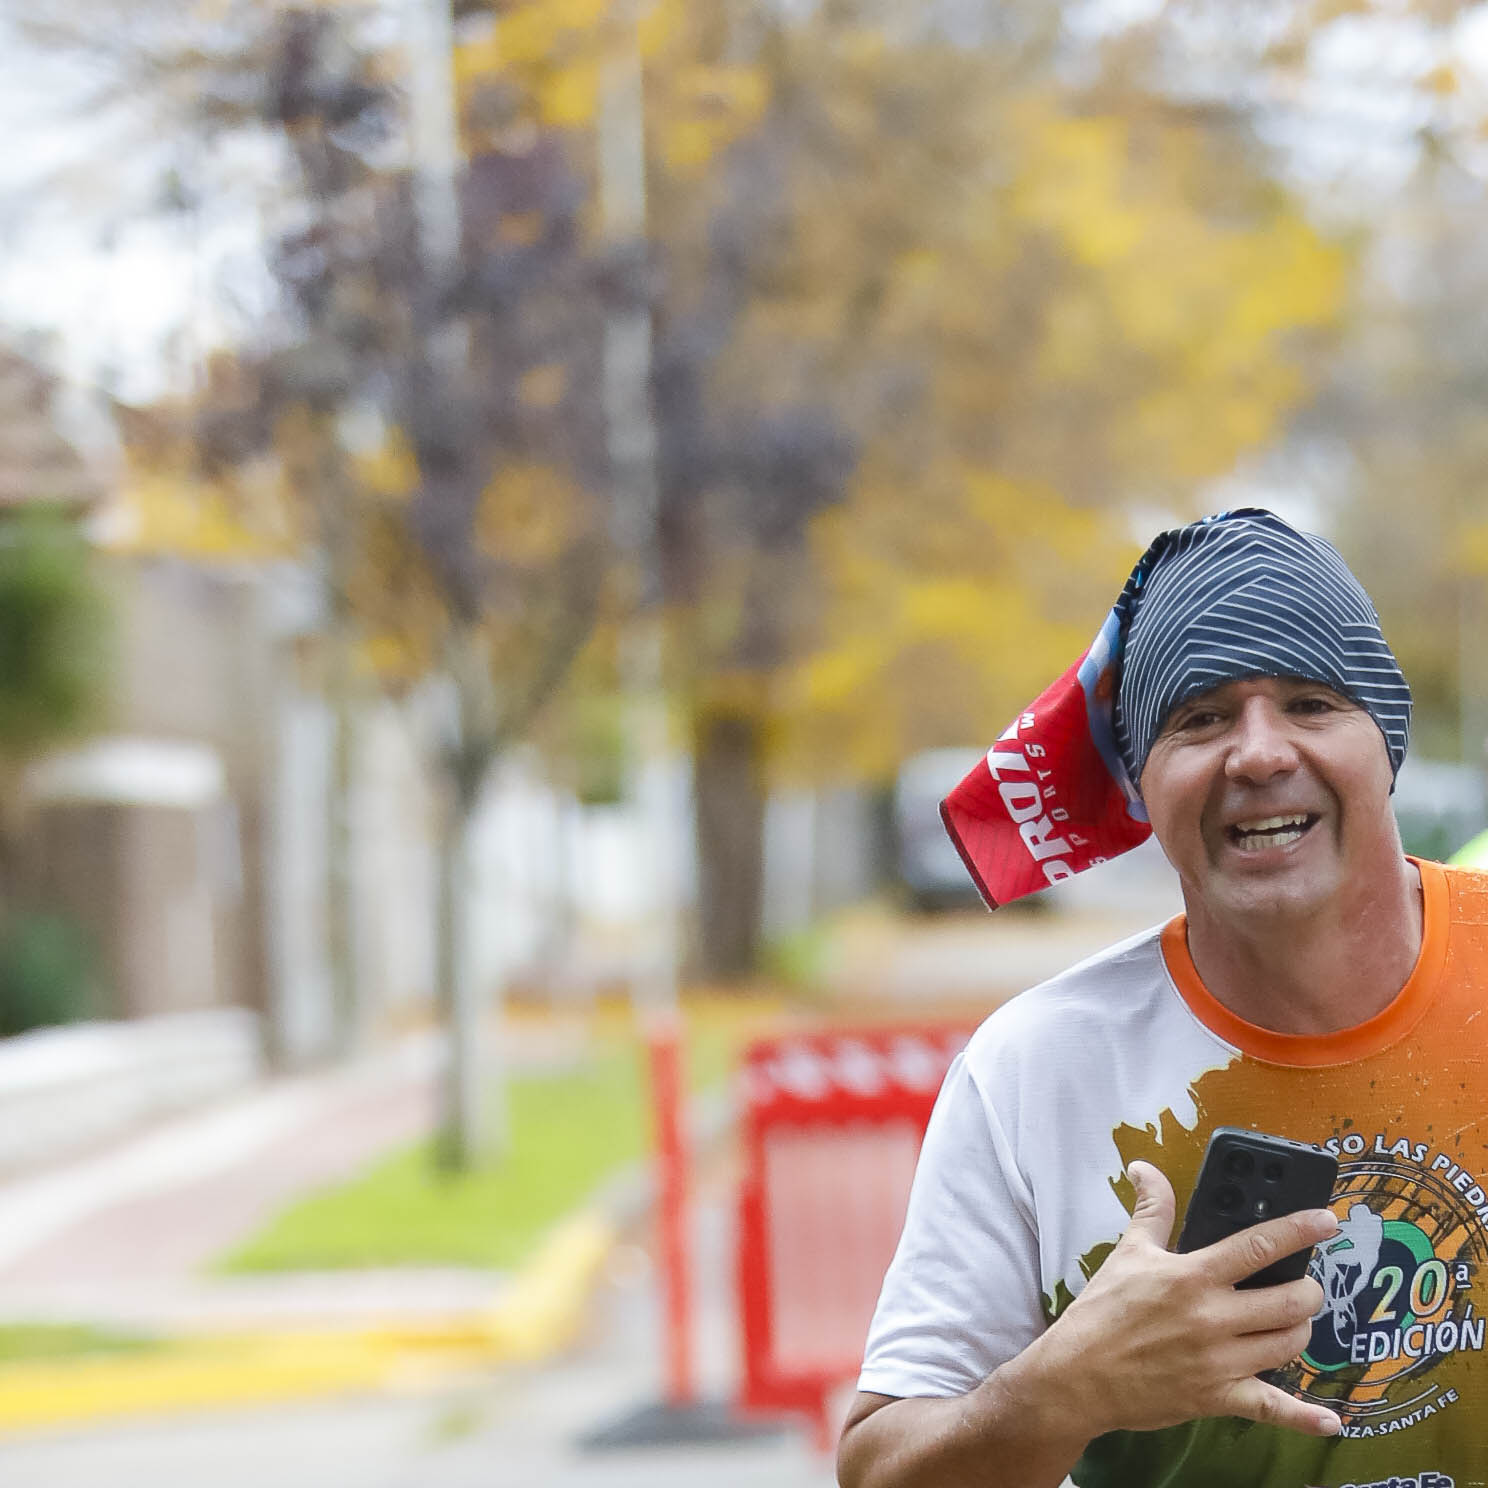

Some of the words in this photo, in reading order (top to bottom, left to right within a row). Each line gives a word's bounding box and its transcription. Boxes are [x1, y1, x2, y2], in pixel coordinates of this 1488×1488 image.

[1324, 1134, 1365, 1156] SO
[1374, 1134, 1430, 1163] LAS
[1350, 1304, 1486, 1364] EDICIÓN
[1339, 1404, 1437, 1438] NZA-SANTA
[1437, 1388, 1459, 1408] FE
